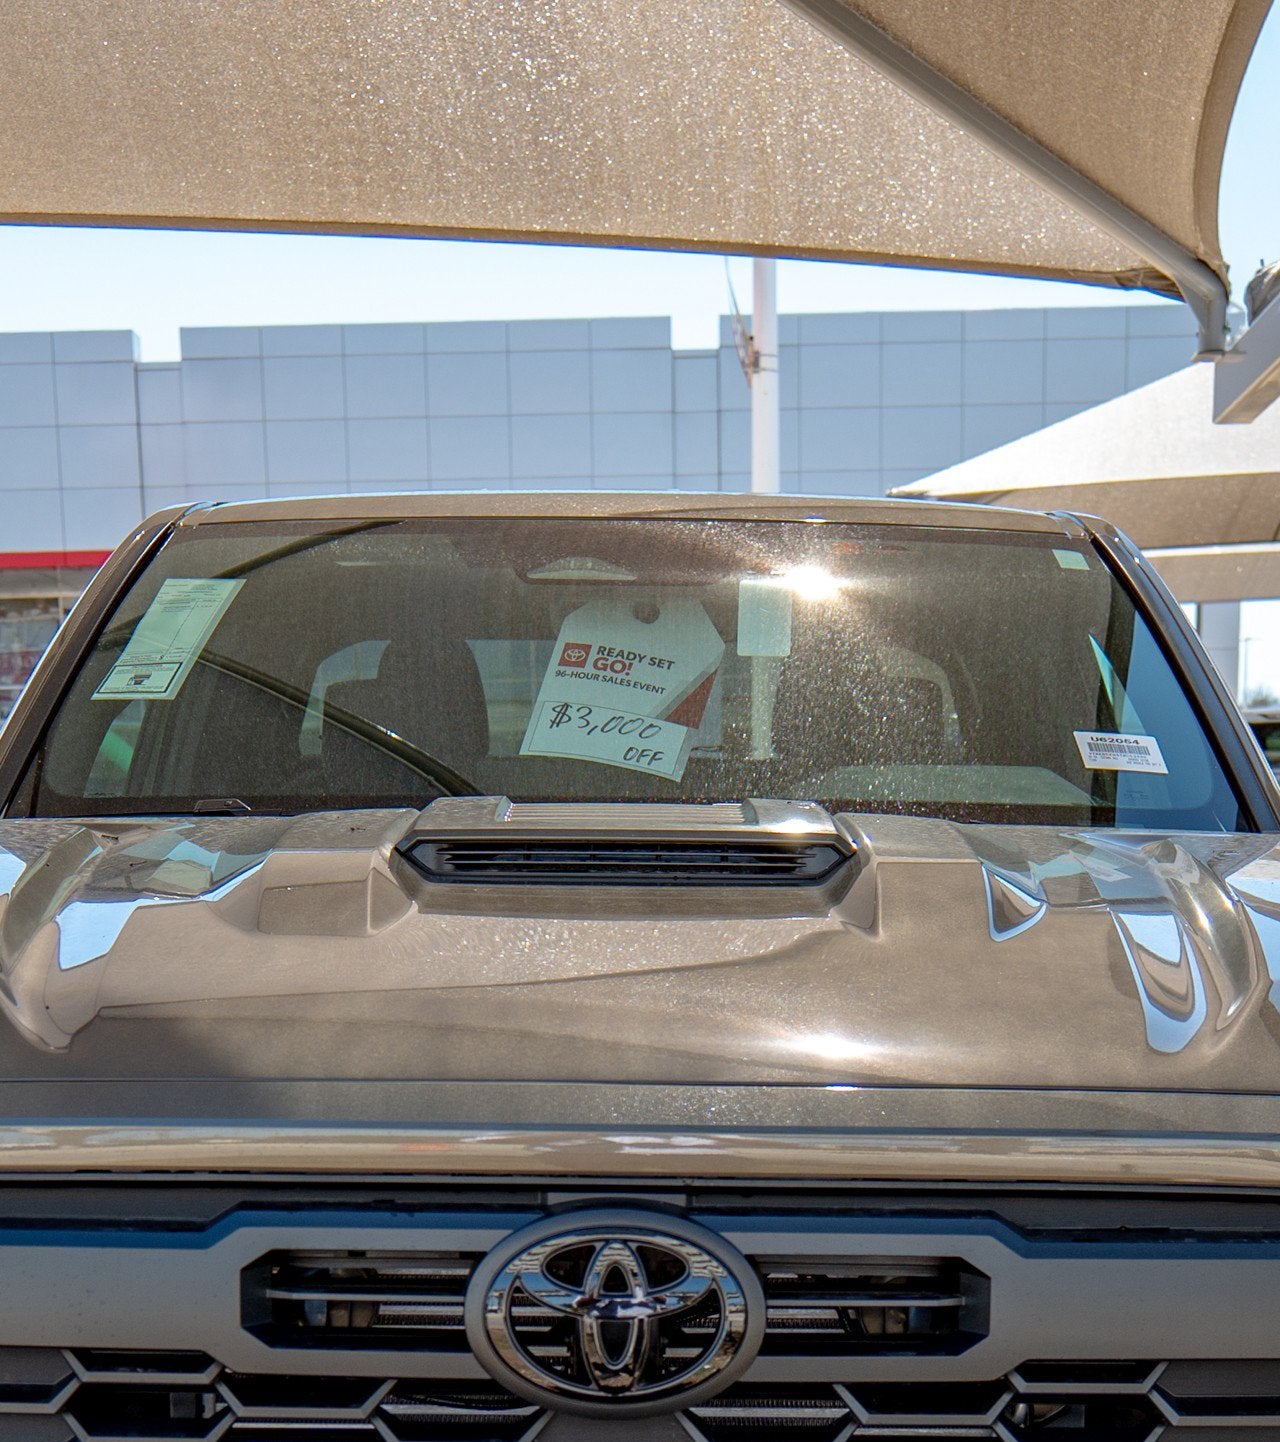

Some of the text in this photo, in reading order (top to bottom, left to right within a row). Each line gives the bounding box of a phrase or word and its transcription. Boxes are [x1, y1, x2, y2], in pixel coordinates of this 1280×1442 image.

[592, 656, 634, 677] GO!
[596, 645, 676, 671] READY SET
[555, 669, 667, 696] 96-HOUR SALES EVENT
[549, 702, 662, 739] $3,000
[622, 746, 665, 767] OFF
